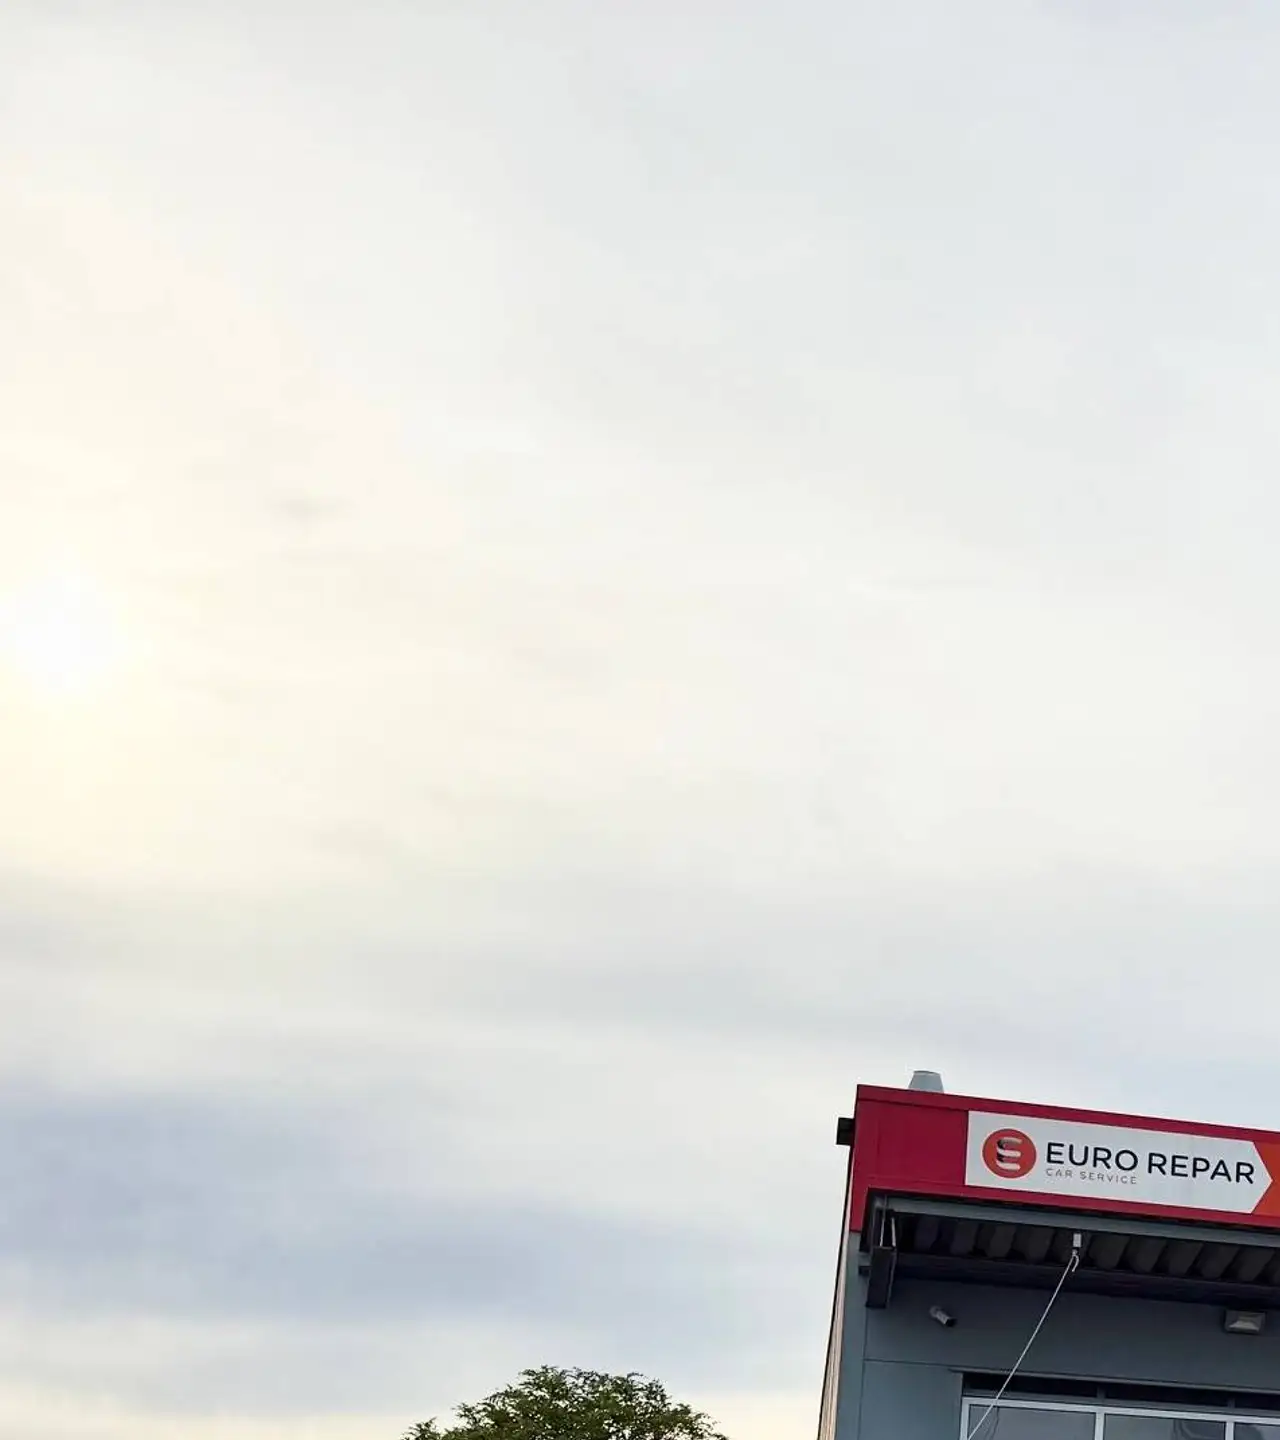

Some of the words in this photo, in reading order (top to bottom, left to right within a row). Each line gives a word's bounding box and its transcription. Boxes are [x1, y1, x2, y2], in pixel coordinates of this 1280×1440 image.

[1045, 1168, 1073, 1178] CAR
[1080, 1171, 1138, 1185] SERVICE
[1046, 1142, 1139, 1171] EURO
[1147, 1152, 1255, 1185] REPAR
